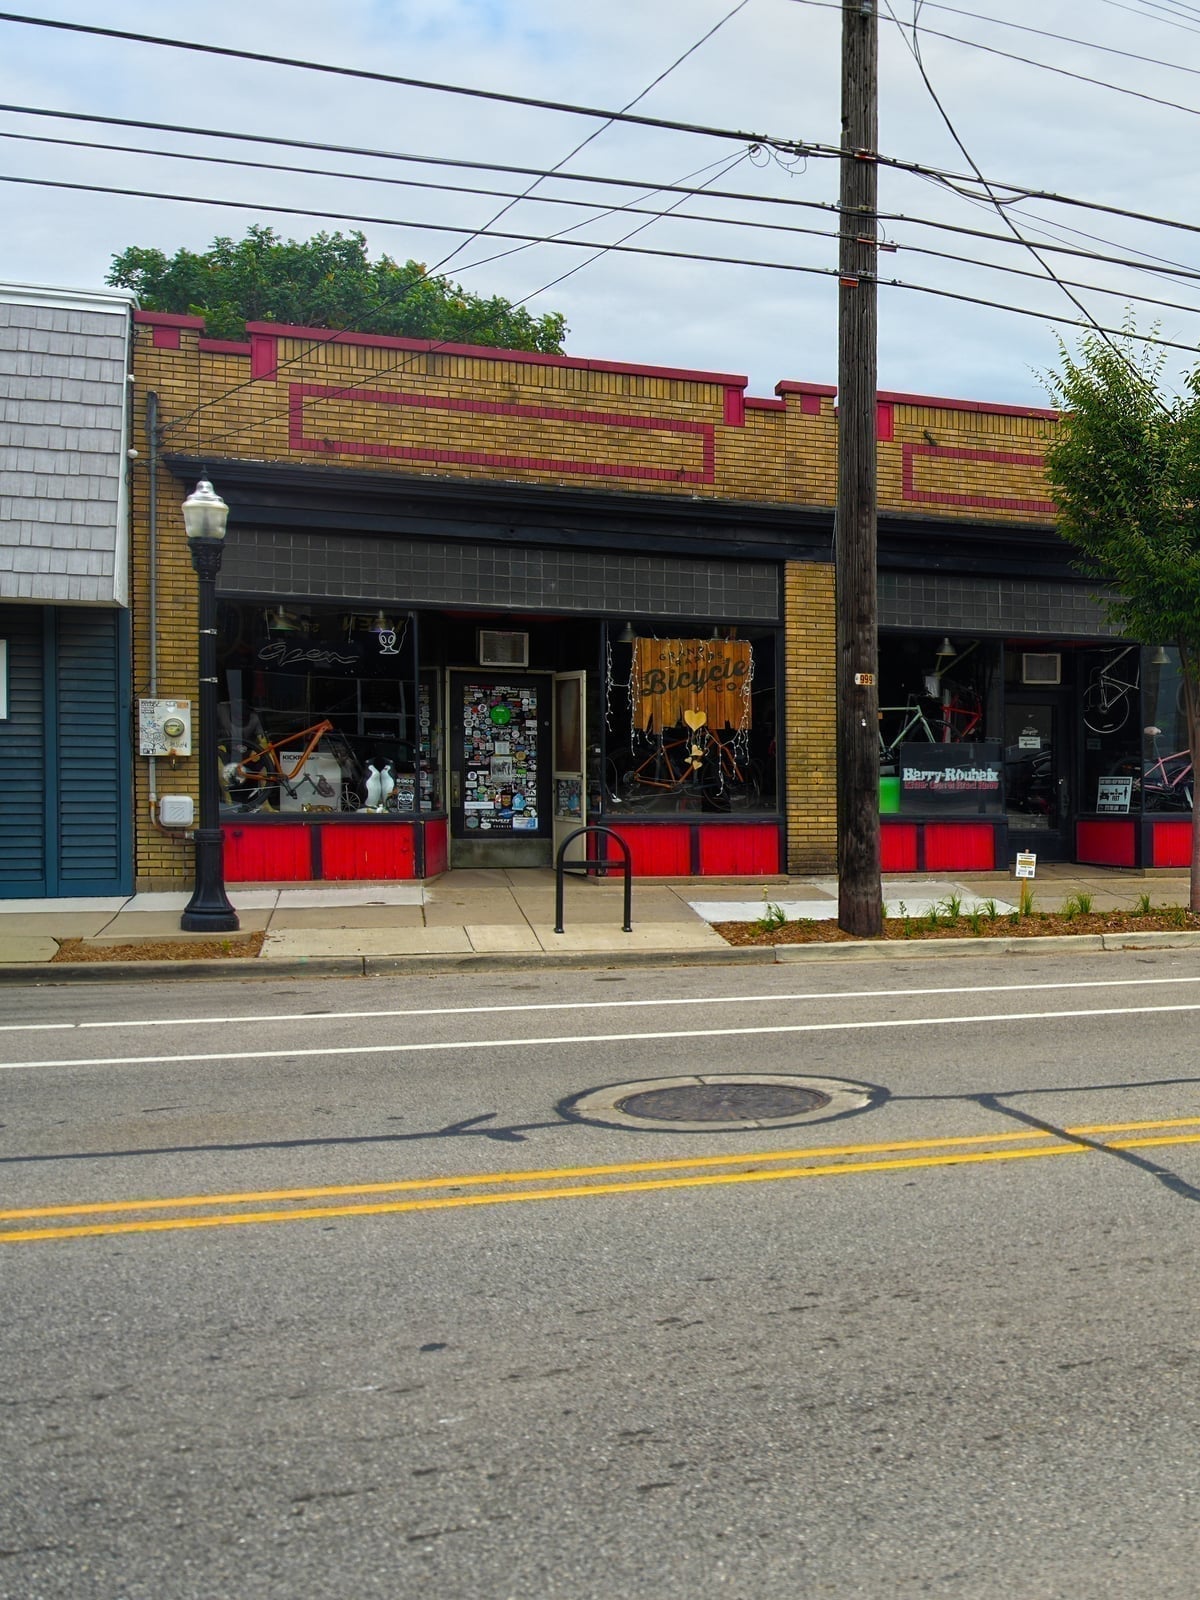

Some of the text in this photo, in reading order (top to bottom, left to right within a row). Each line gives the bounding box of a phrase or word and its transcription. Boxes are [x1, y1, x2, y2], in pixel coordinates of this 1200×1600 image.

[258, 642, 359, 667] Open
[659, 646, 705, 660] GRAND
[640, 657, 748, 696] Bicycle
[860, 674, 873, 684] 999
